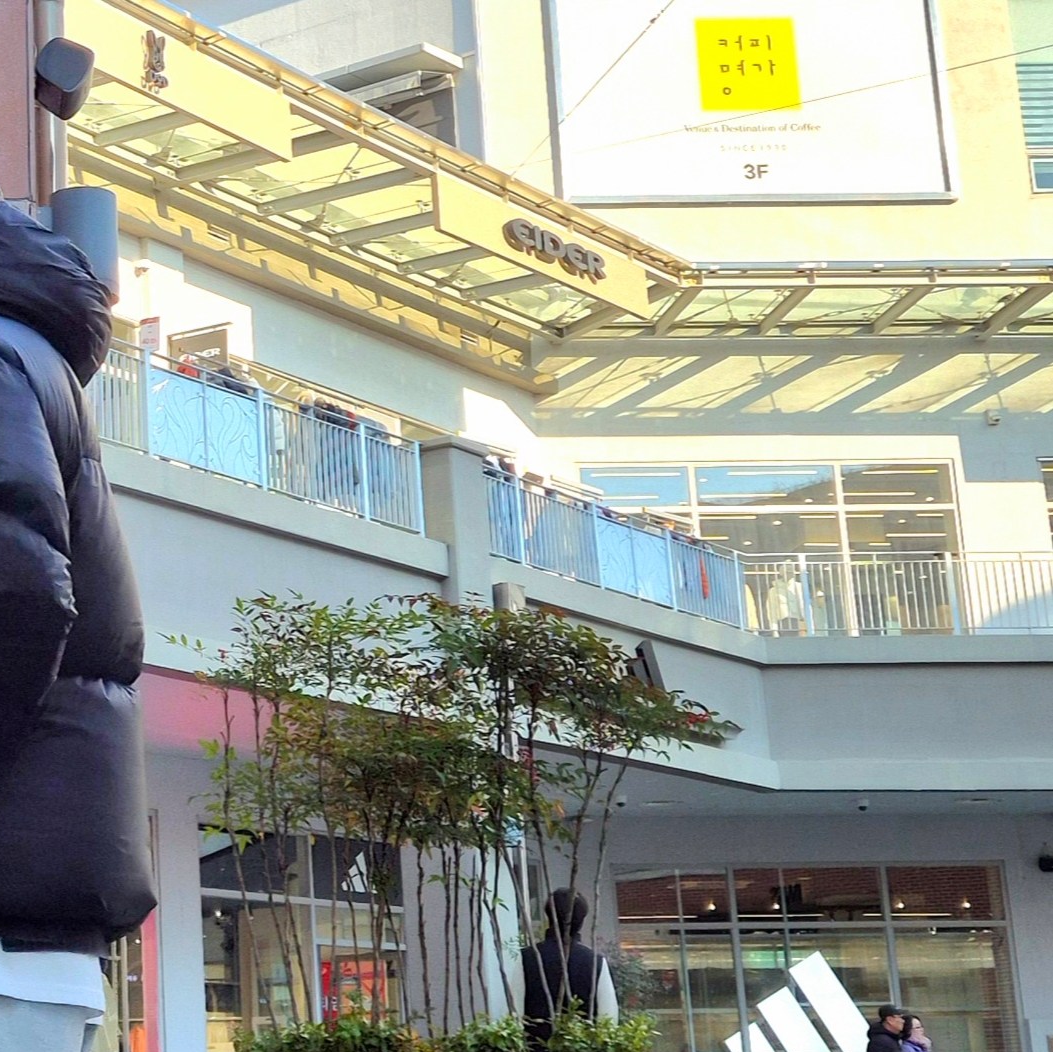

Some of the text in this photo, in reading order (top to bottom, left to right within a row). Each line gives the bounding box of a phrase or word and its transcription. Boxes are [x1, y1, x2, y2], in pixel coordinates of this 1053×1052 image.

[721, 124, 776, 132] Destination
[778, 123, 788, 132] of
[790, 123, 821, 132] Coffee
[720, 144, 756, 152] SINCE
[743, 163, 769, 180] 3F
[503, 218, 608, 281] EIDER
